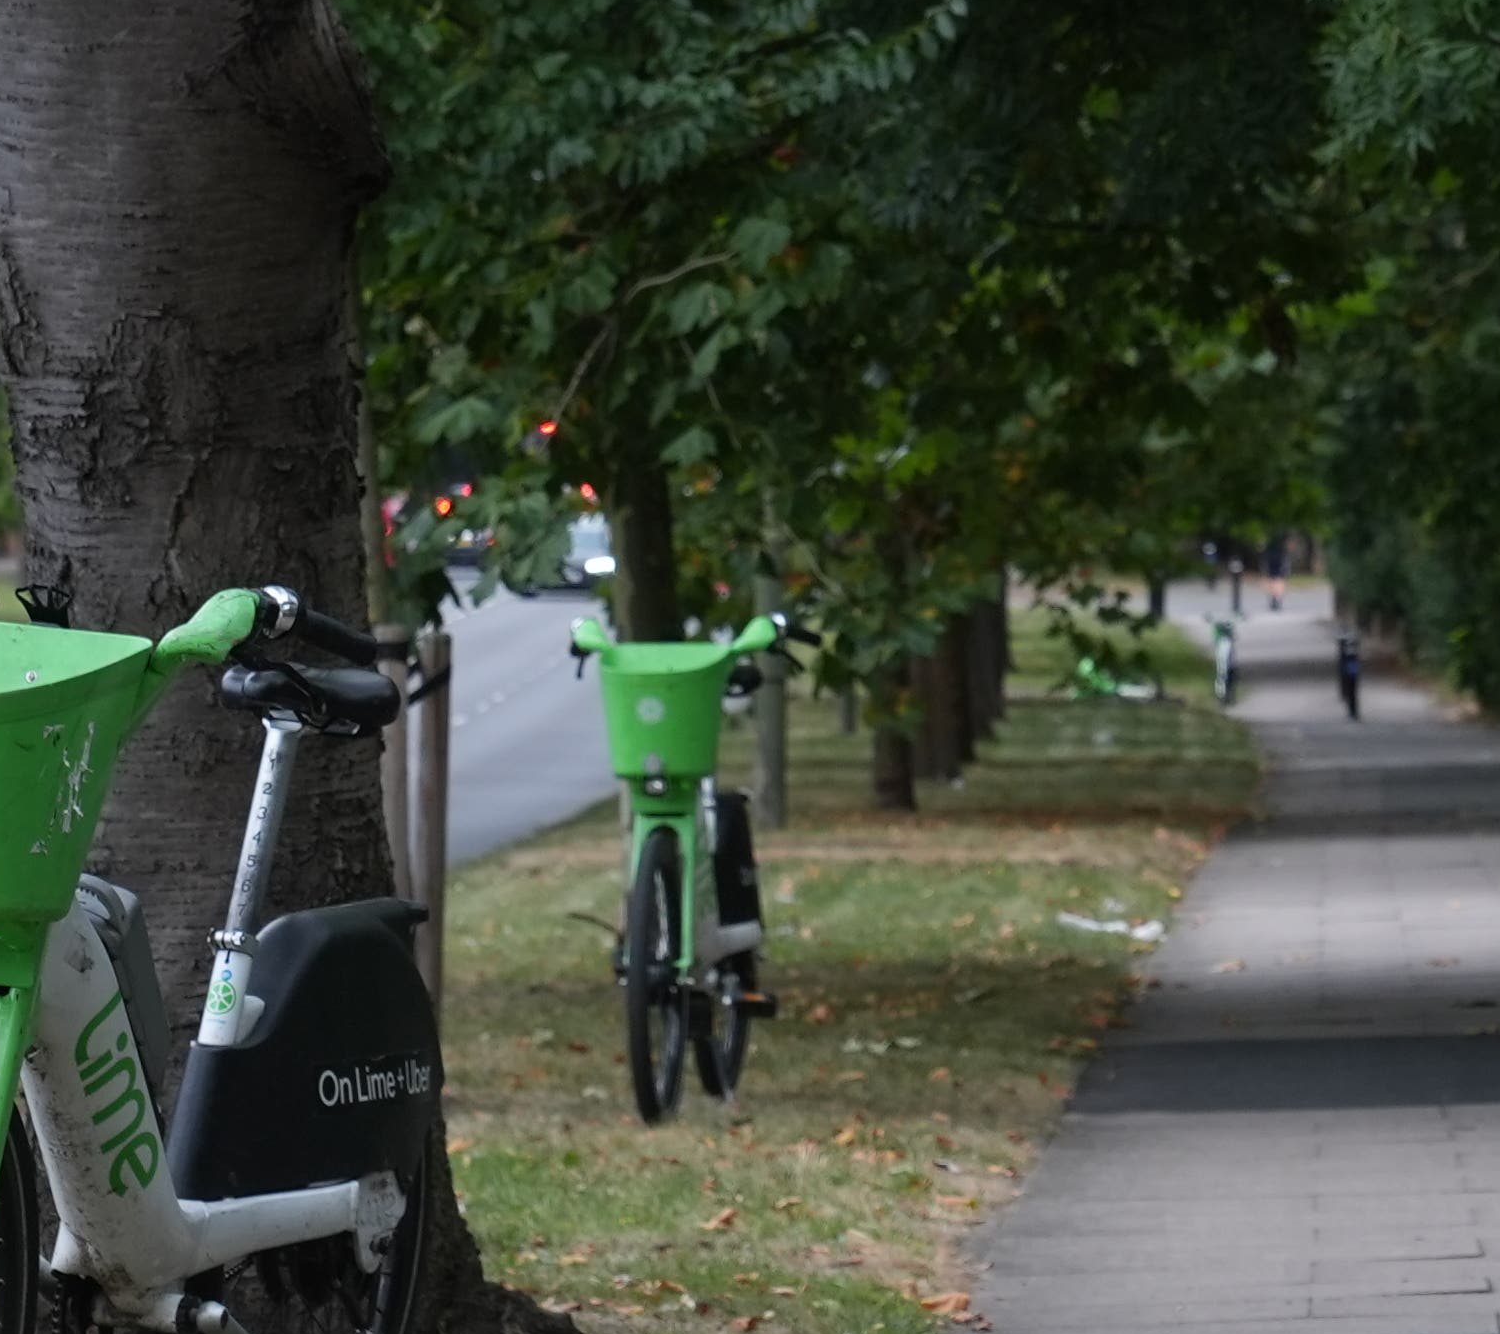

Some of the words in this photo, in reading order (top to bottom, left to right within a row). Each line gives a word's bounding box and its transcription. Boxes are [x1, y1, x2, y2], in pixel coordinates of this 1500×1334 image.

[263, 782, 272, 795] 2
[257, 806, 267, 819] 3
[253, 831, 261, 843] 4
[247, 855, 256, 867] 5
[241, 879, 251, 893] 6
[238, 904, 247, 916] 7
[319, 1070, 353, 1107] On
[355, 1065, 396, 1102] Lime
[397, 1068, 404, 1089] +
[405, 1059, 431, 1095] Uber
[75, 990, 159, 1198] Lime
